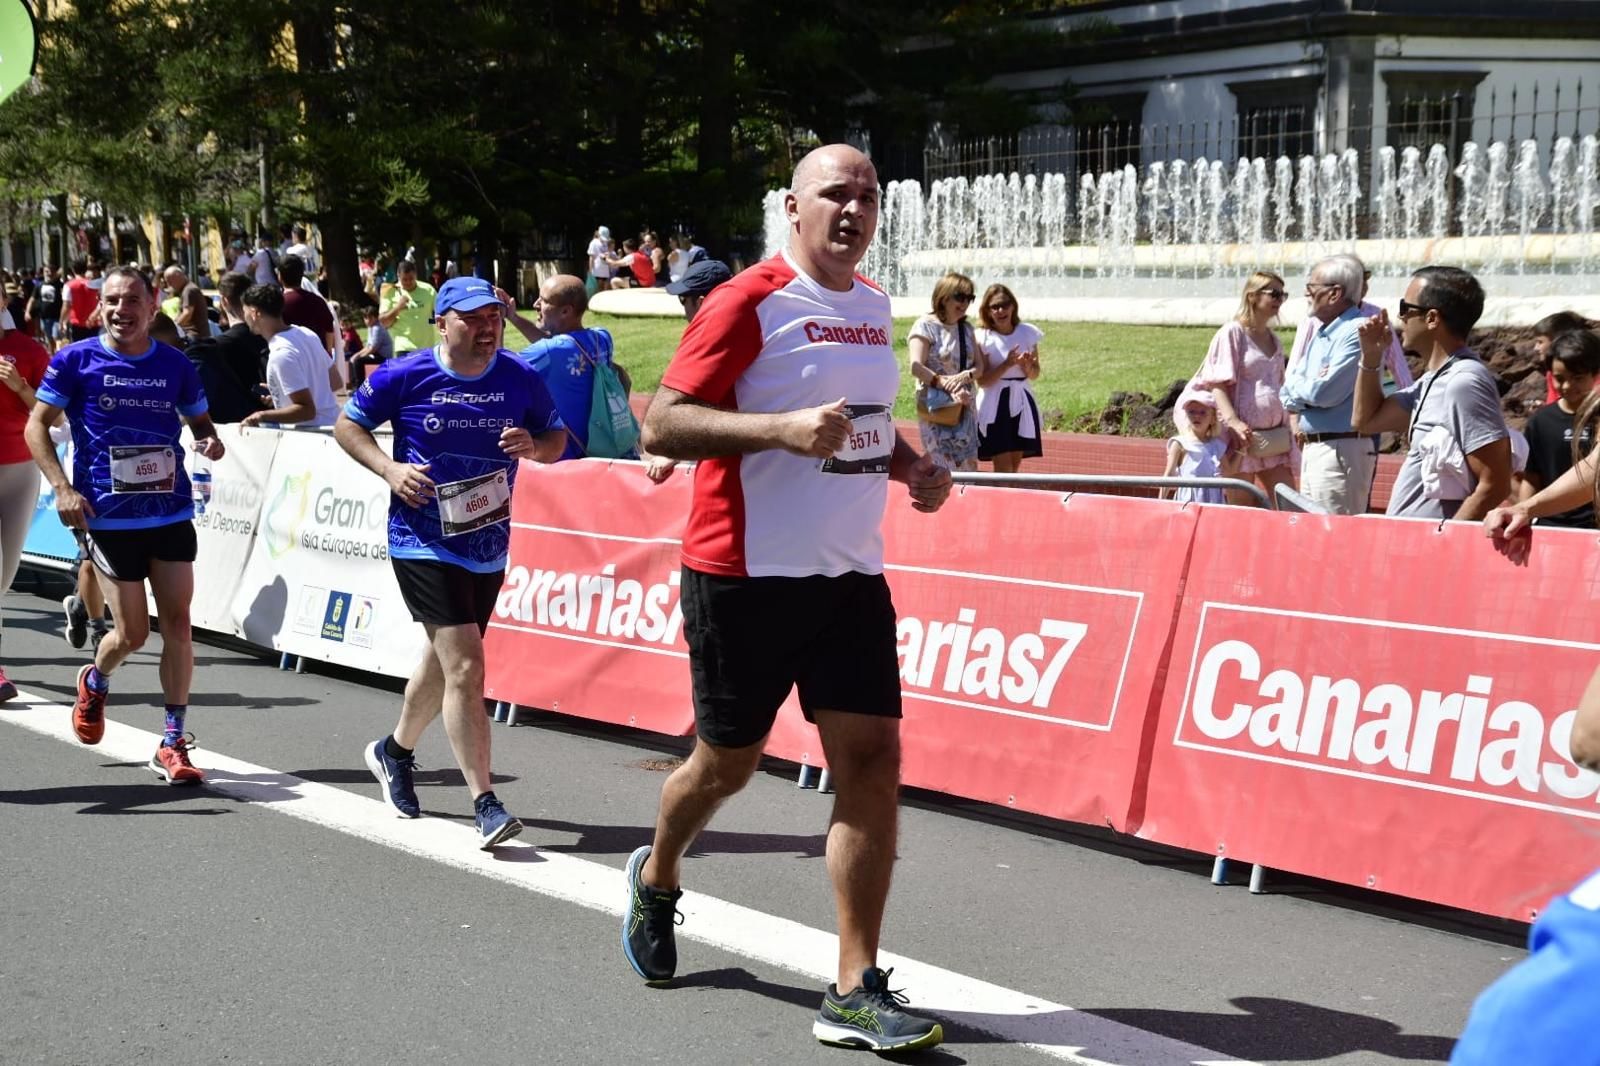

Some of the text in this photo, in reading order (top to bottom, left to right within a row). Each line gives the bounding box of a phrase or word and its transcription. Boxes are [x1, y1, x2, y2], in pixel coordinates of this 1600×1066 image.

[119, 398, 172, 409] MOLECOR
[447, 418, 514, 429] MOLECOR
[850, 429, 880, 451] 5574
[135, 462, 159, 477] 4592
[465, 495, 489, 514] 4608
[212, 511, 252, 537] Deporte
[321, 533, 367, 560] Europea
[896, 607, 1089, 709] arias7
[1191, 640, 1600, 803] Canarias
